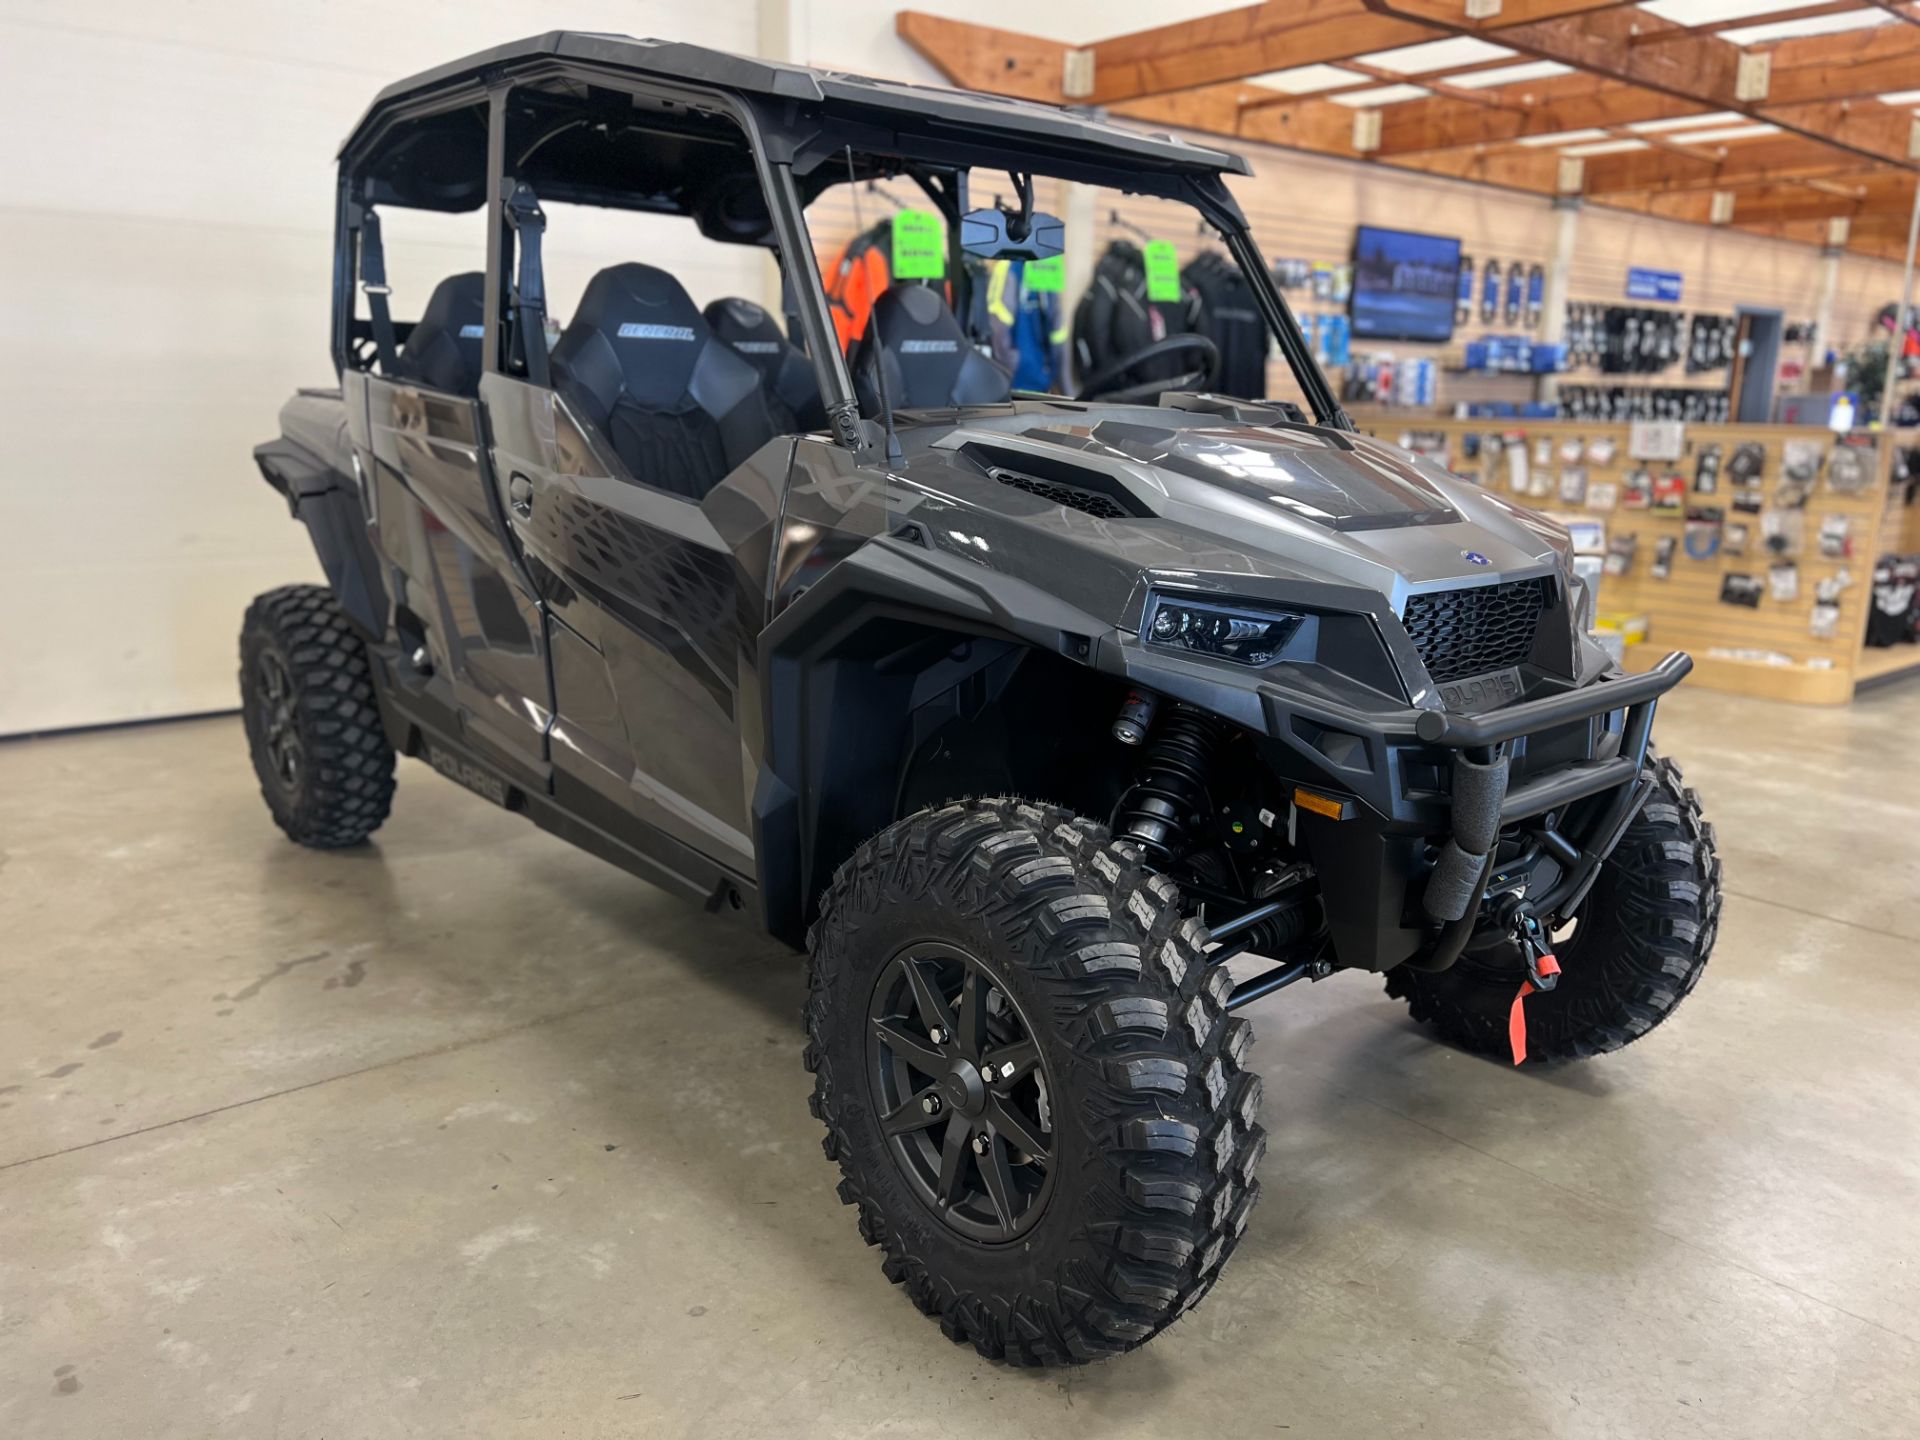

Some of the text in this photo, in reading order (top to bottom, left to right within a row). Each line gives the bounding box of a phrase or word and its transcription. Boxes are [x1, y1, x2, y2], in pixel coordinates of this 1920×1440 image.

[617, 322, 696, 341] GENERAL
[1438, 673, 1516, 708] OLARIS
[430, 744, 505, 807] POLARIS
